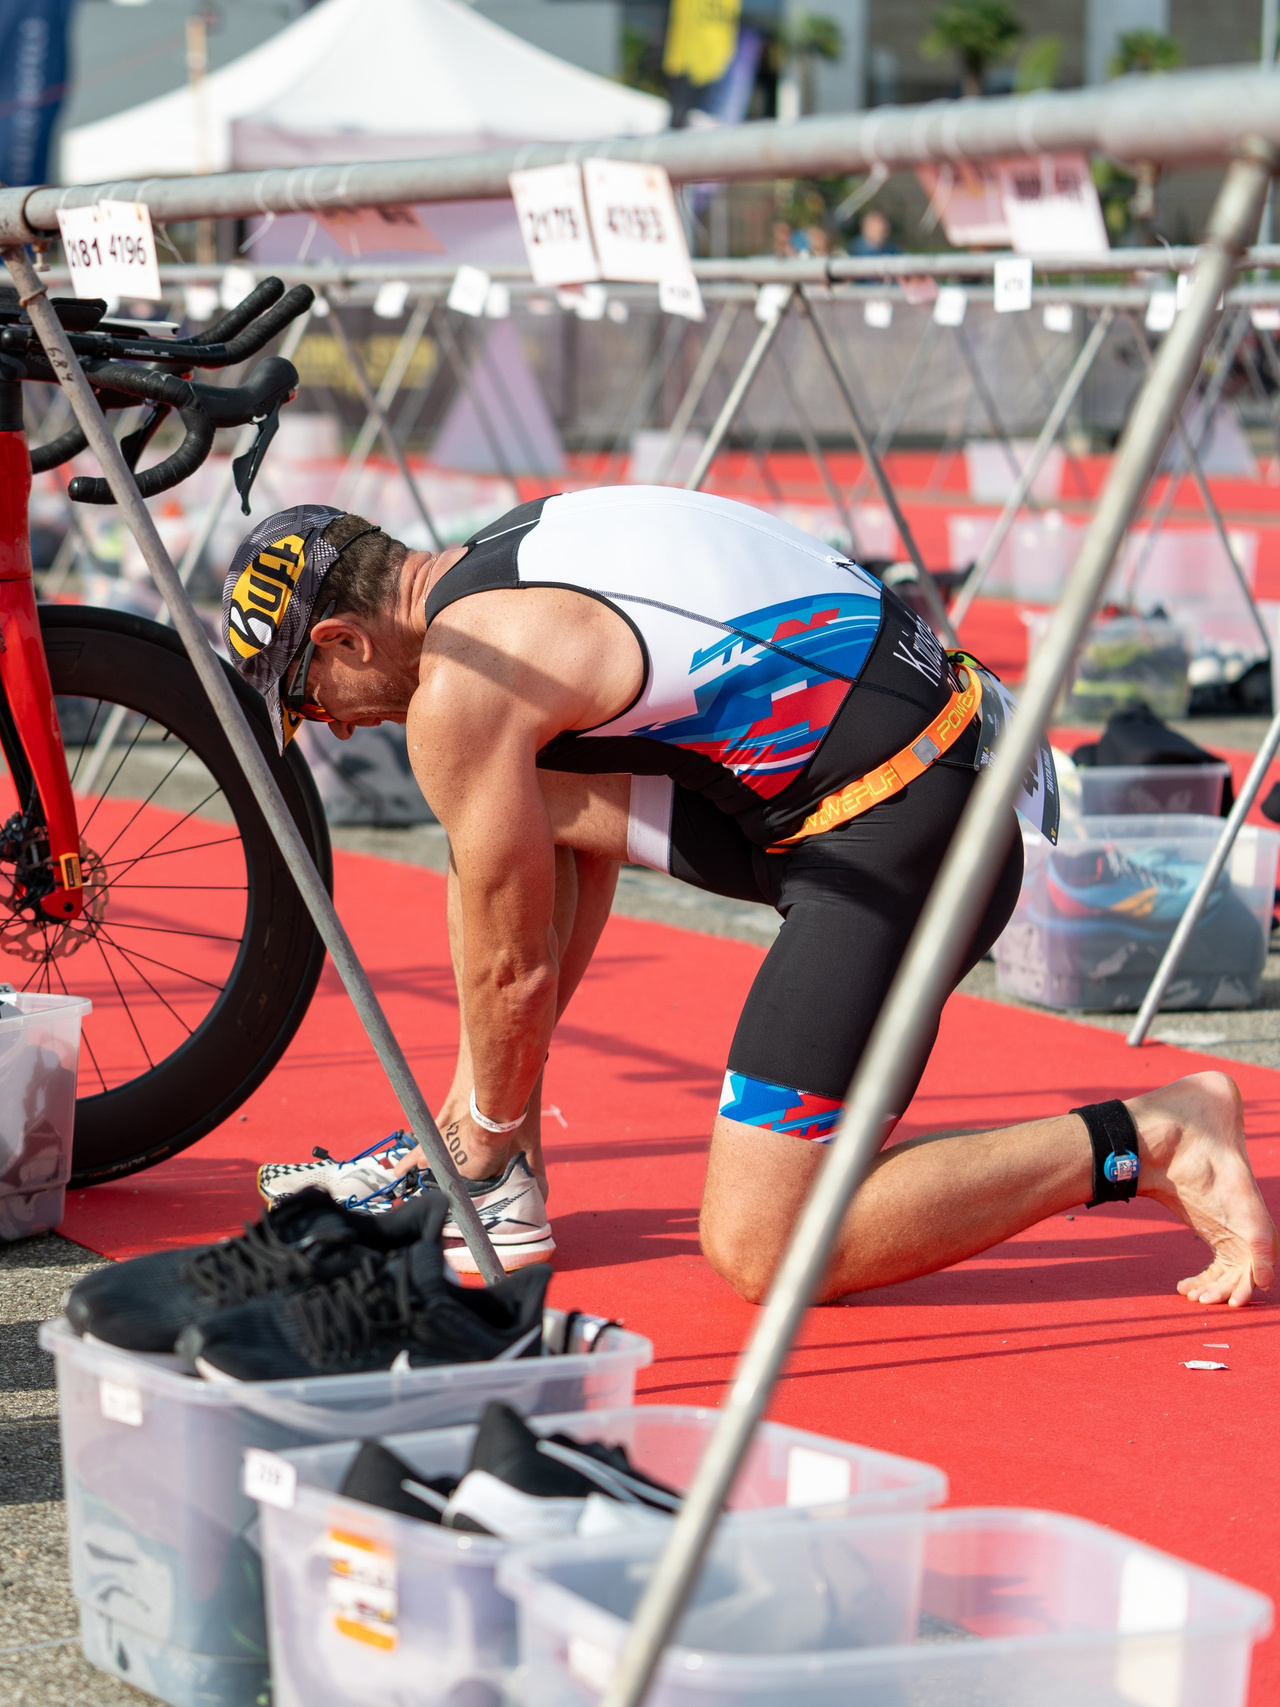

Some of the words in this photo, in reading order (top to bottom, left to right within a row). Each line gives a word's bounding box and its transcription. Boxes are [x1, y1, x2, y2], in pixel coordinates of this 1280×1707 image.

[67, 238, 102, 267] 2181
[109, 234, 147, 265] 4196
[46, 346, 75, 383] 684
